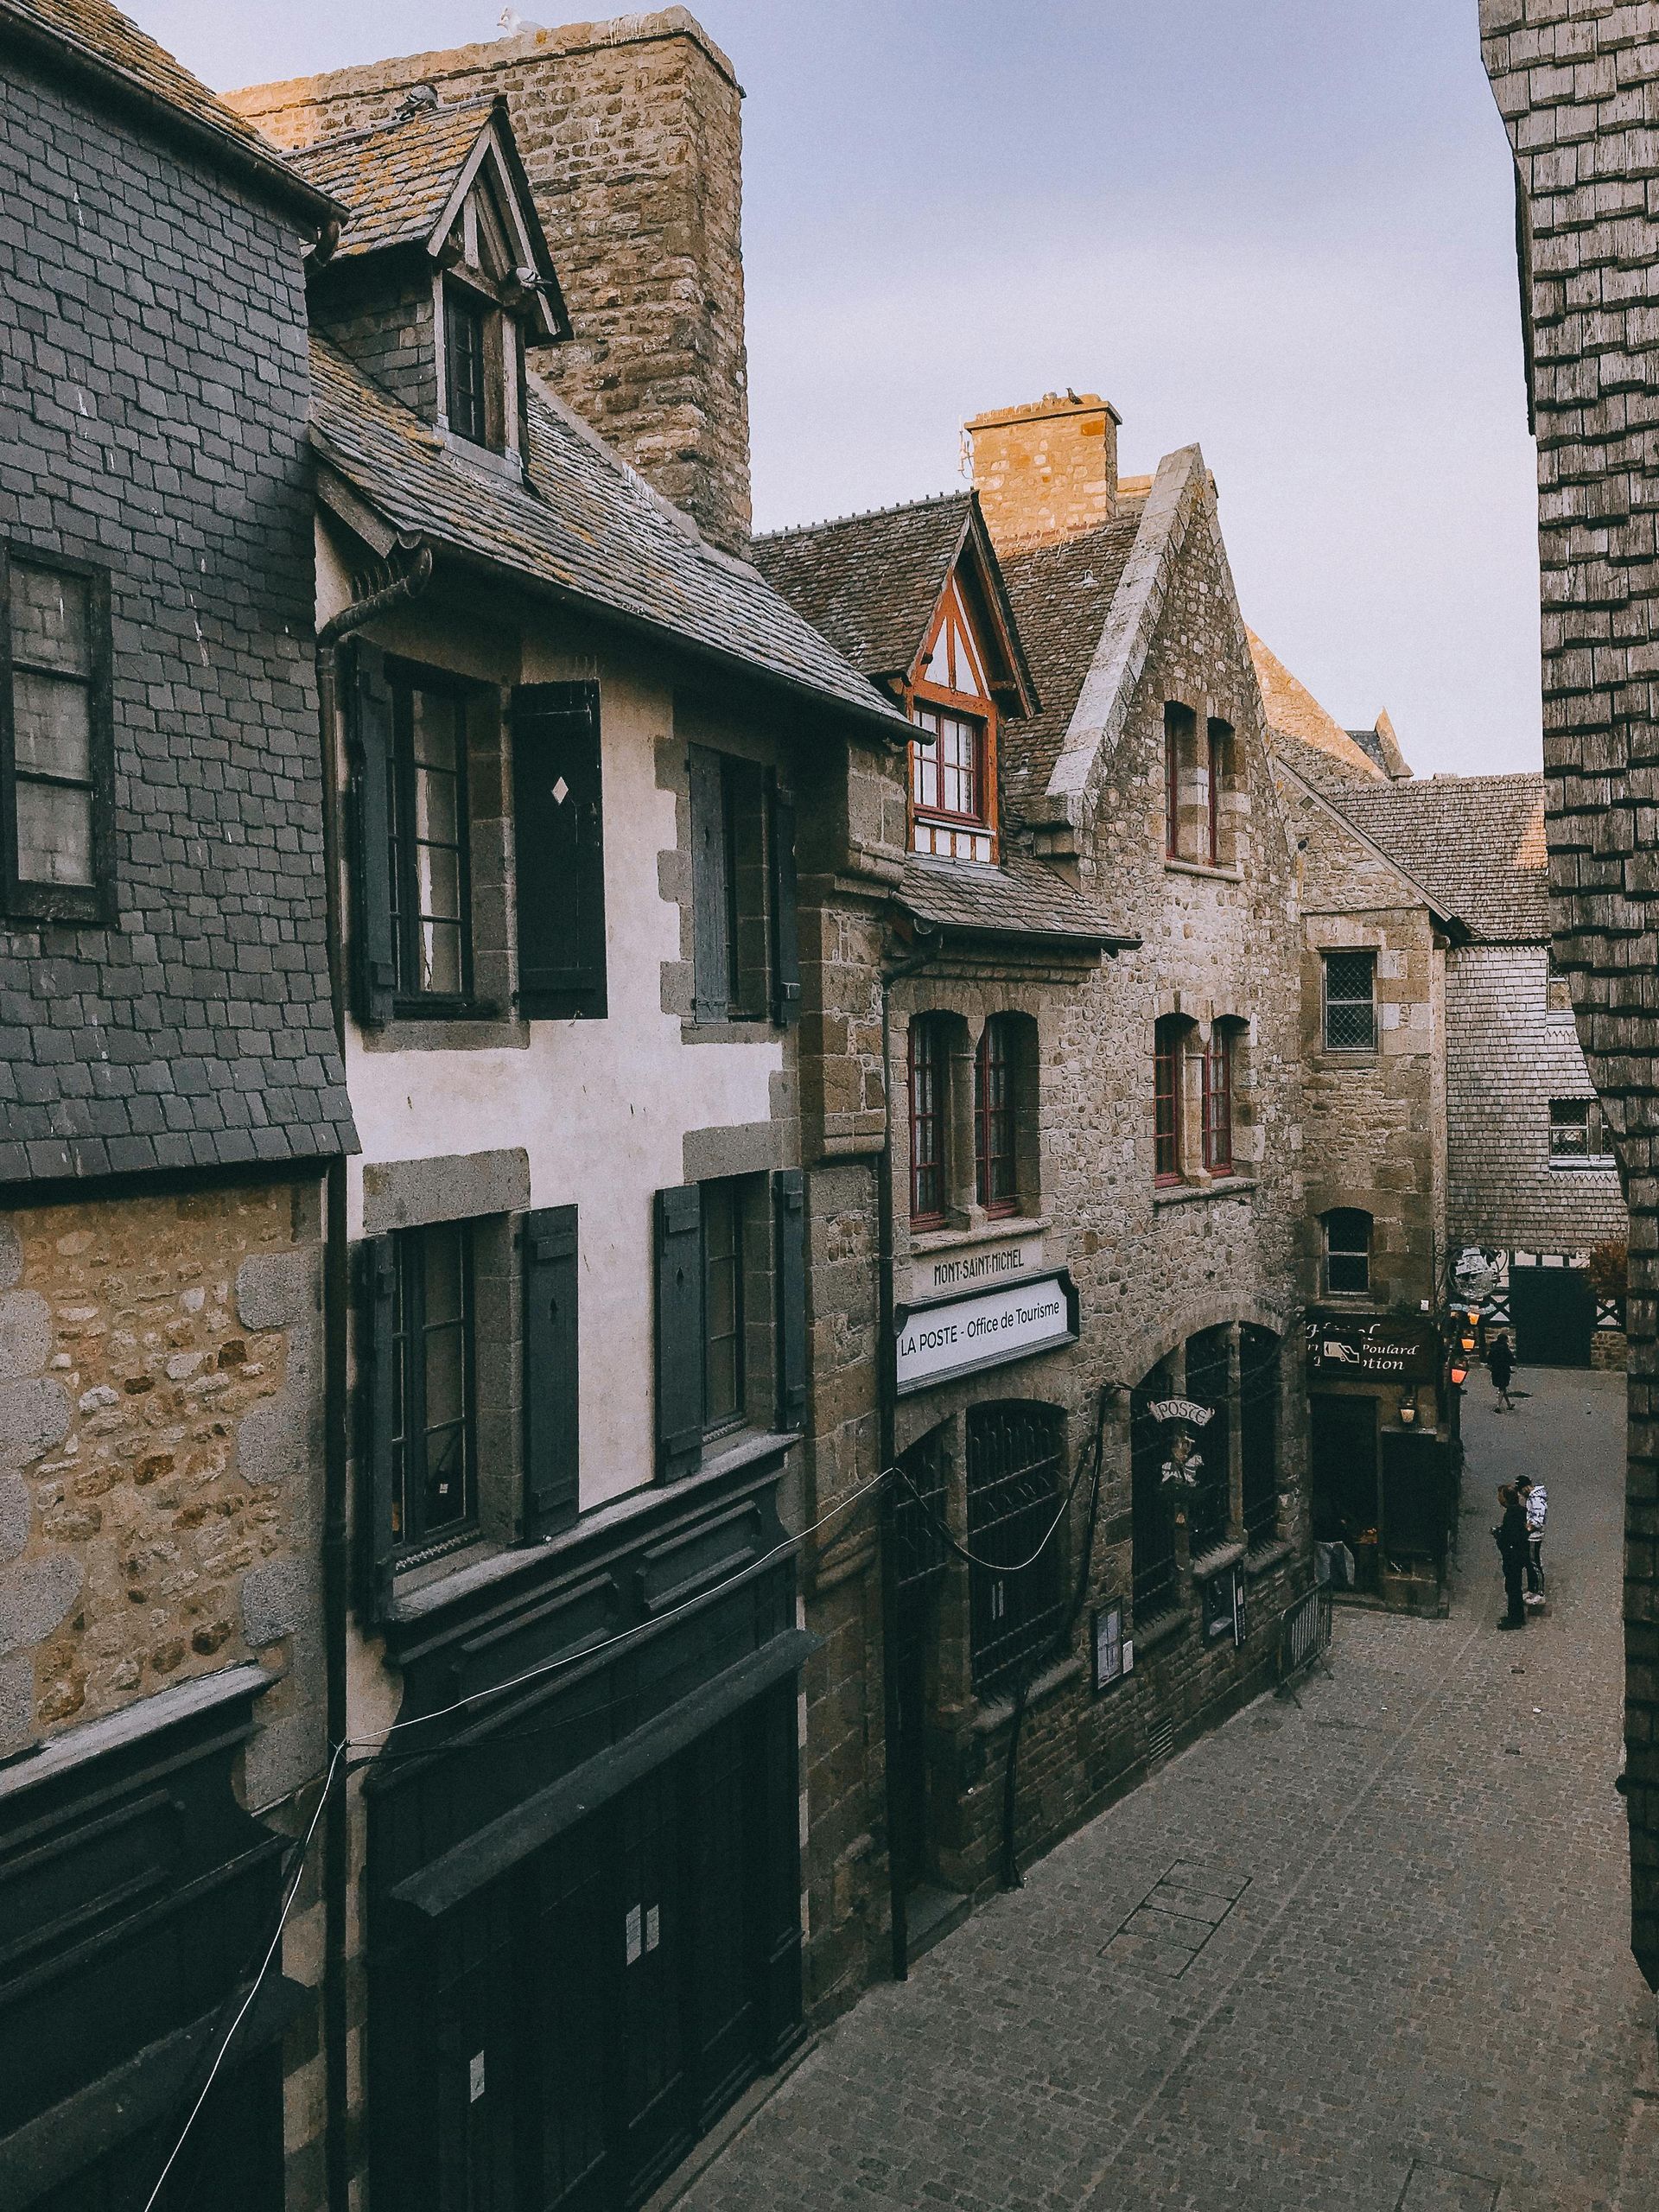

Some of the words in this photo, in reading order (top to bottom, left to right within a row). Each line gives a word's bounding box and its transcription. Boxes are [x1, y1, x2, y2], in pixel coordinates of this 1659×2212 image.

[900, 1336, 917, 1357] LA
[919, 1325, 958, 1351] POSTE
[967, 1317, 998, 1338] Office
[1001, 1311, 1014, 1328] de
[1016, 1301, 1059, 1325] Tourisme
[1363, 1344, 1420, 1356] Poulard
[1158, 1401, 1207, 1424] POSTE
